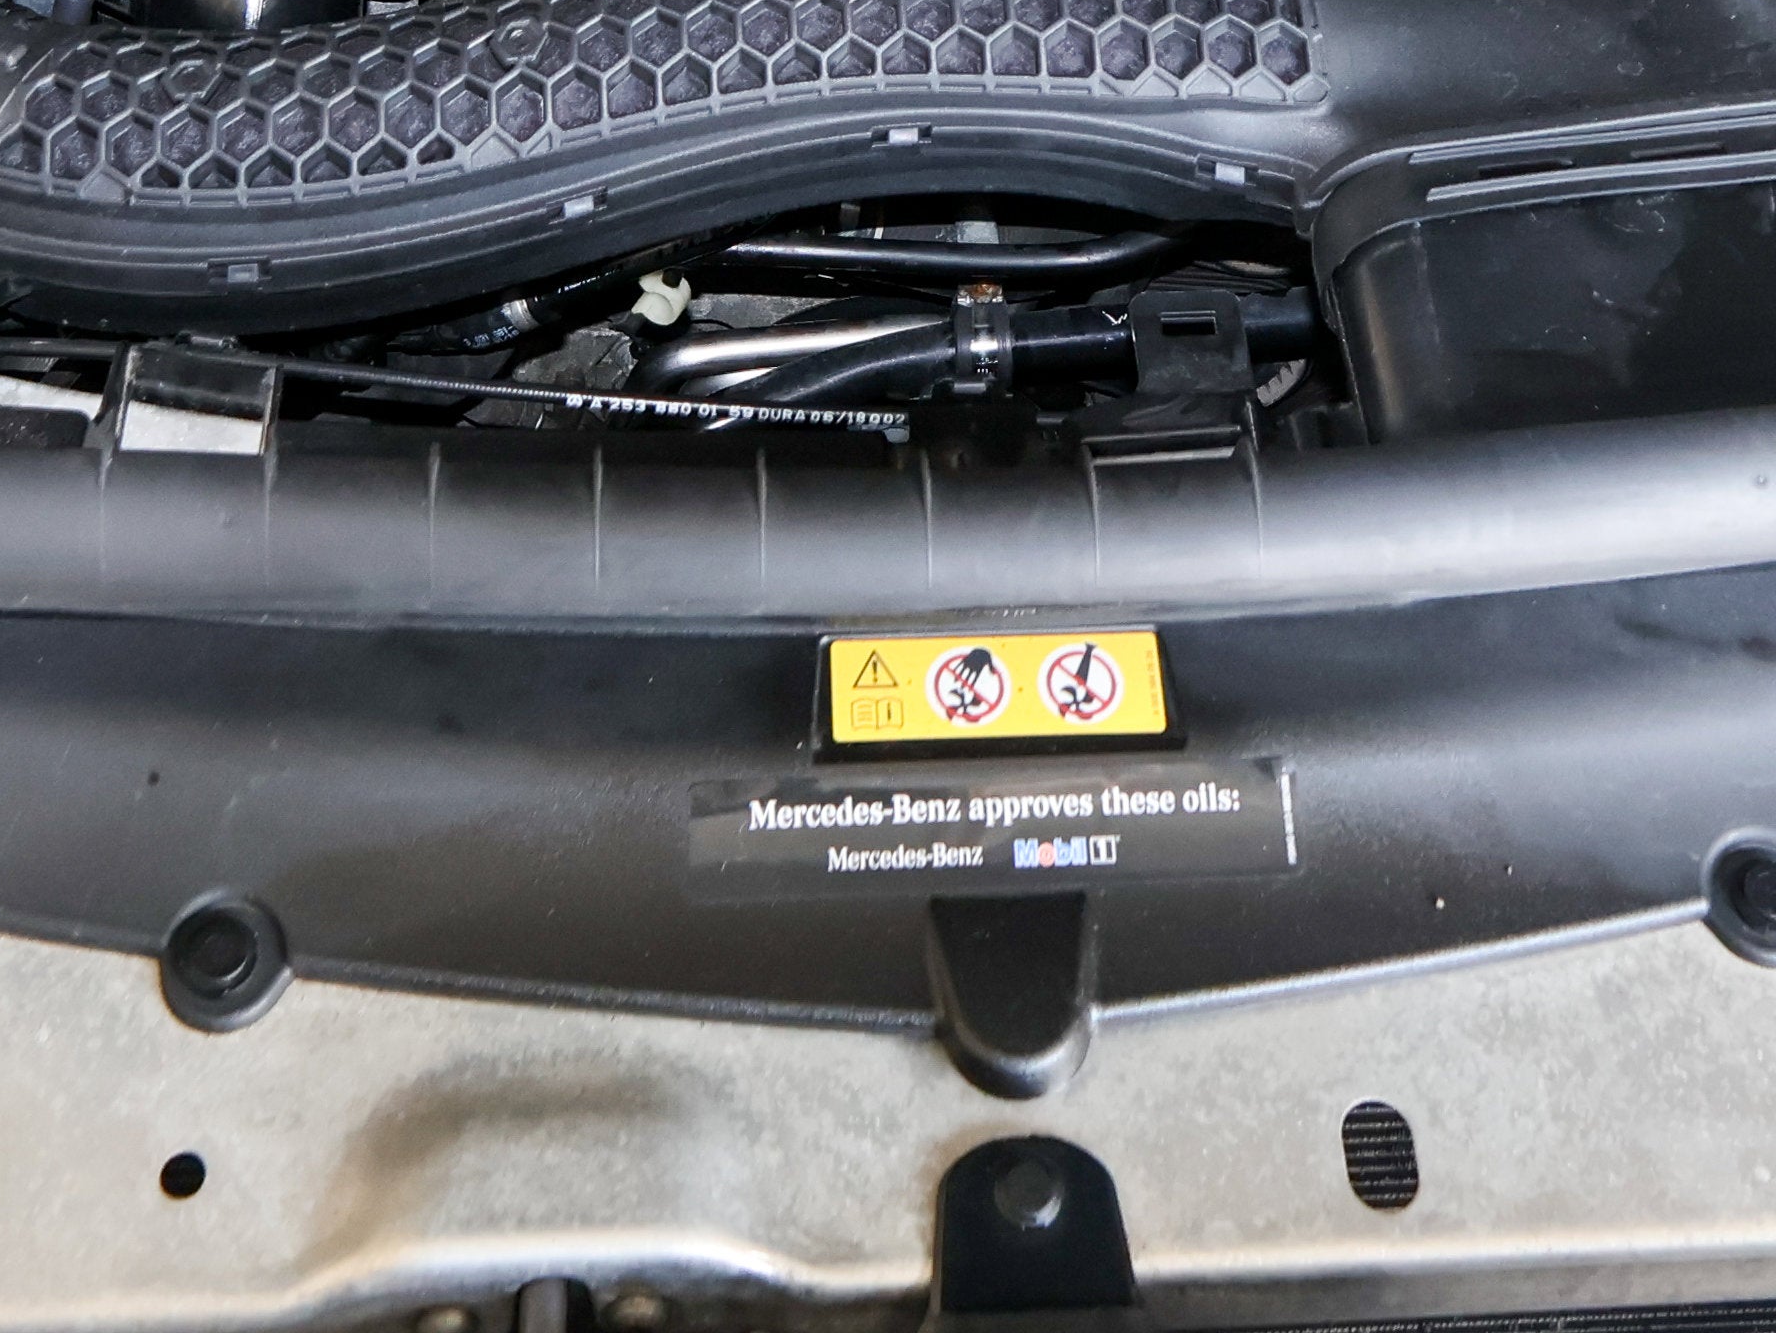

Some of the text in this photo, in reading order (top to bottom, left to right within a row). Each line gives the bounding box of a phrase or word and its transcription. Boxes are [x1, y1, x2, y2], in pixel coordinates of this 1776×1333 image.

[609, 397, 646, 413] 253
[698, 403, 718, 418] 01
[758, 407, 806, 421] DURA
[749, 782, 1240, 831] Mercedes-Benz approves these oils:
[827, 842, 984, 873] Mercedes-Benz
[1014, 836, 1088, 868] Mobil
